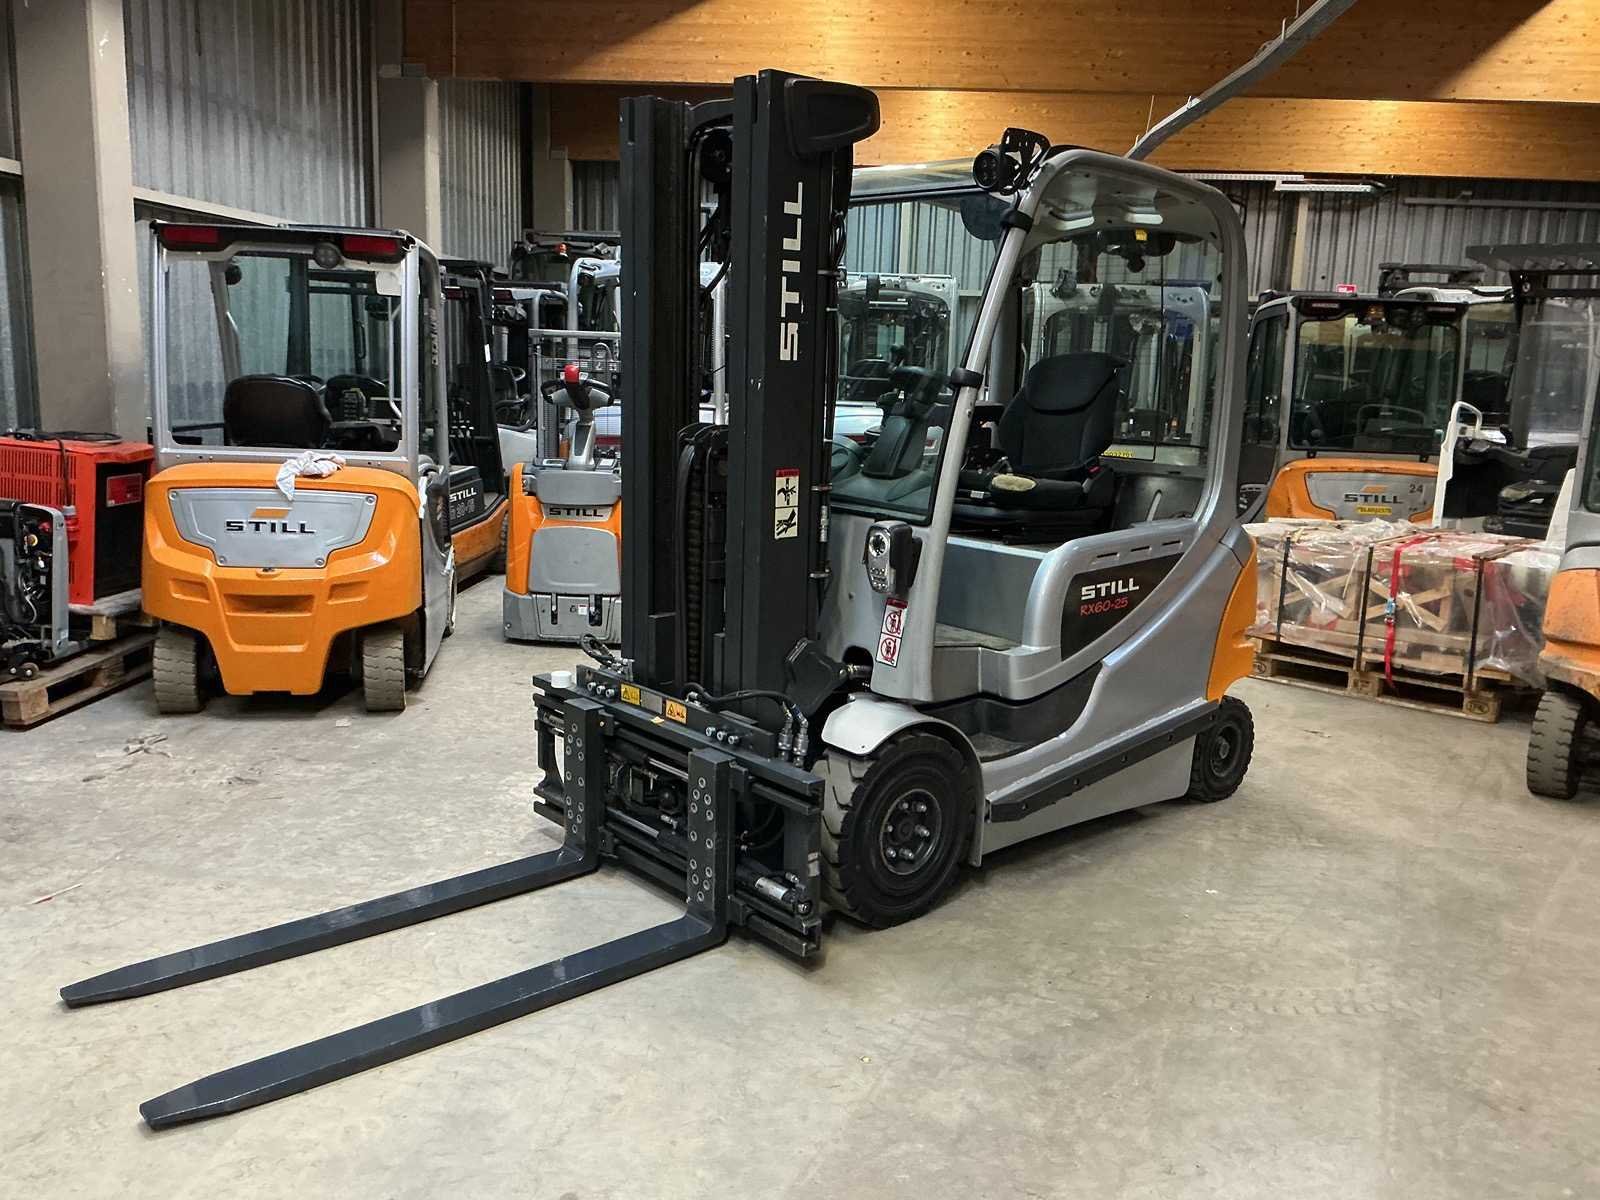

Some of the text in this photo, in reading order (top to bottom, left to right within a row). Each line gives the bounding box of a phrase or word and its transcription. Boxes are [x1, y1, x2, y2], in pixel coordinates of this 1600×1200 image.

[780, 182, 803, 361] STILL
[449, 487, 477, 503] STILL
[1409, 483, 1424, 494] 24
[1344, 493, 1404, 504] STILL
[549, 507, 604, 518] STILL
[226, 520, 316, 534] STILL
[1081, 578, 1140, 601] STILL
[1080, 597, 1129, 616] RX60-25
